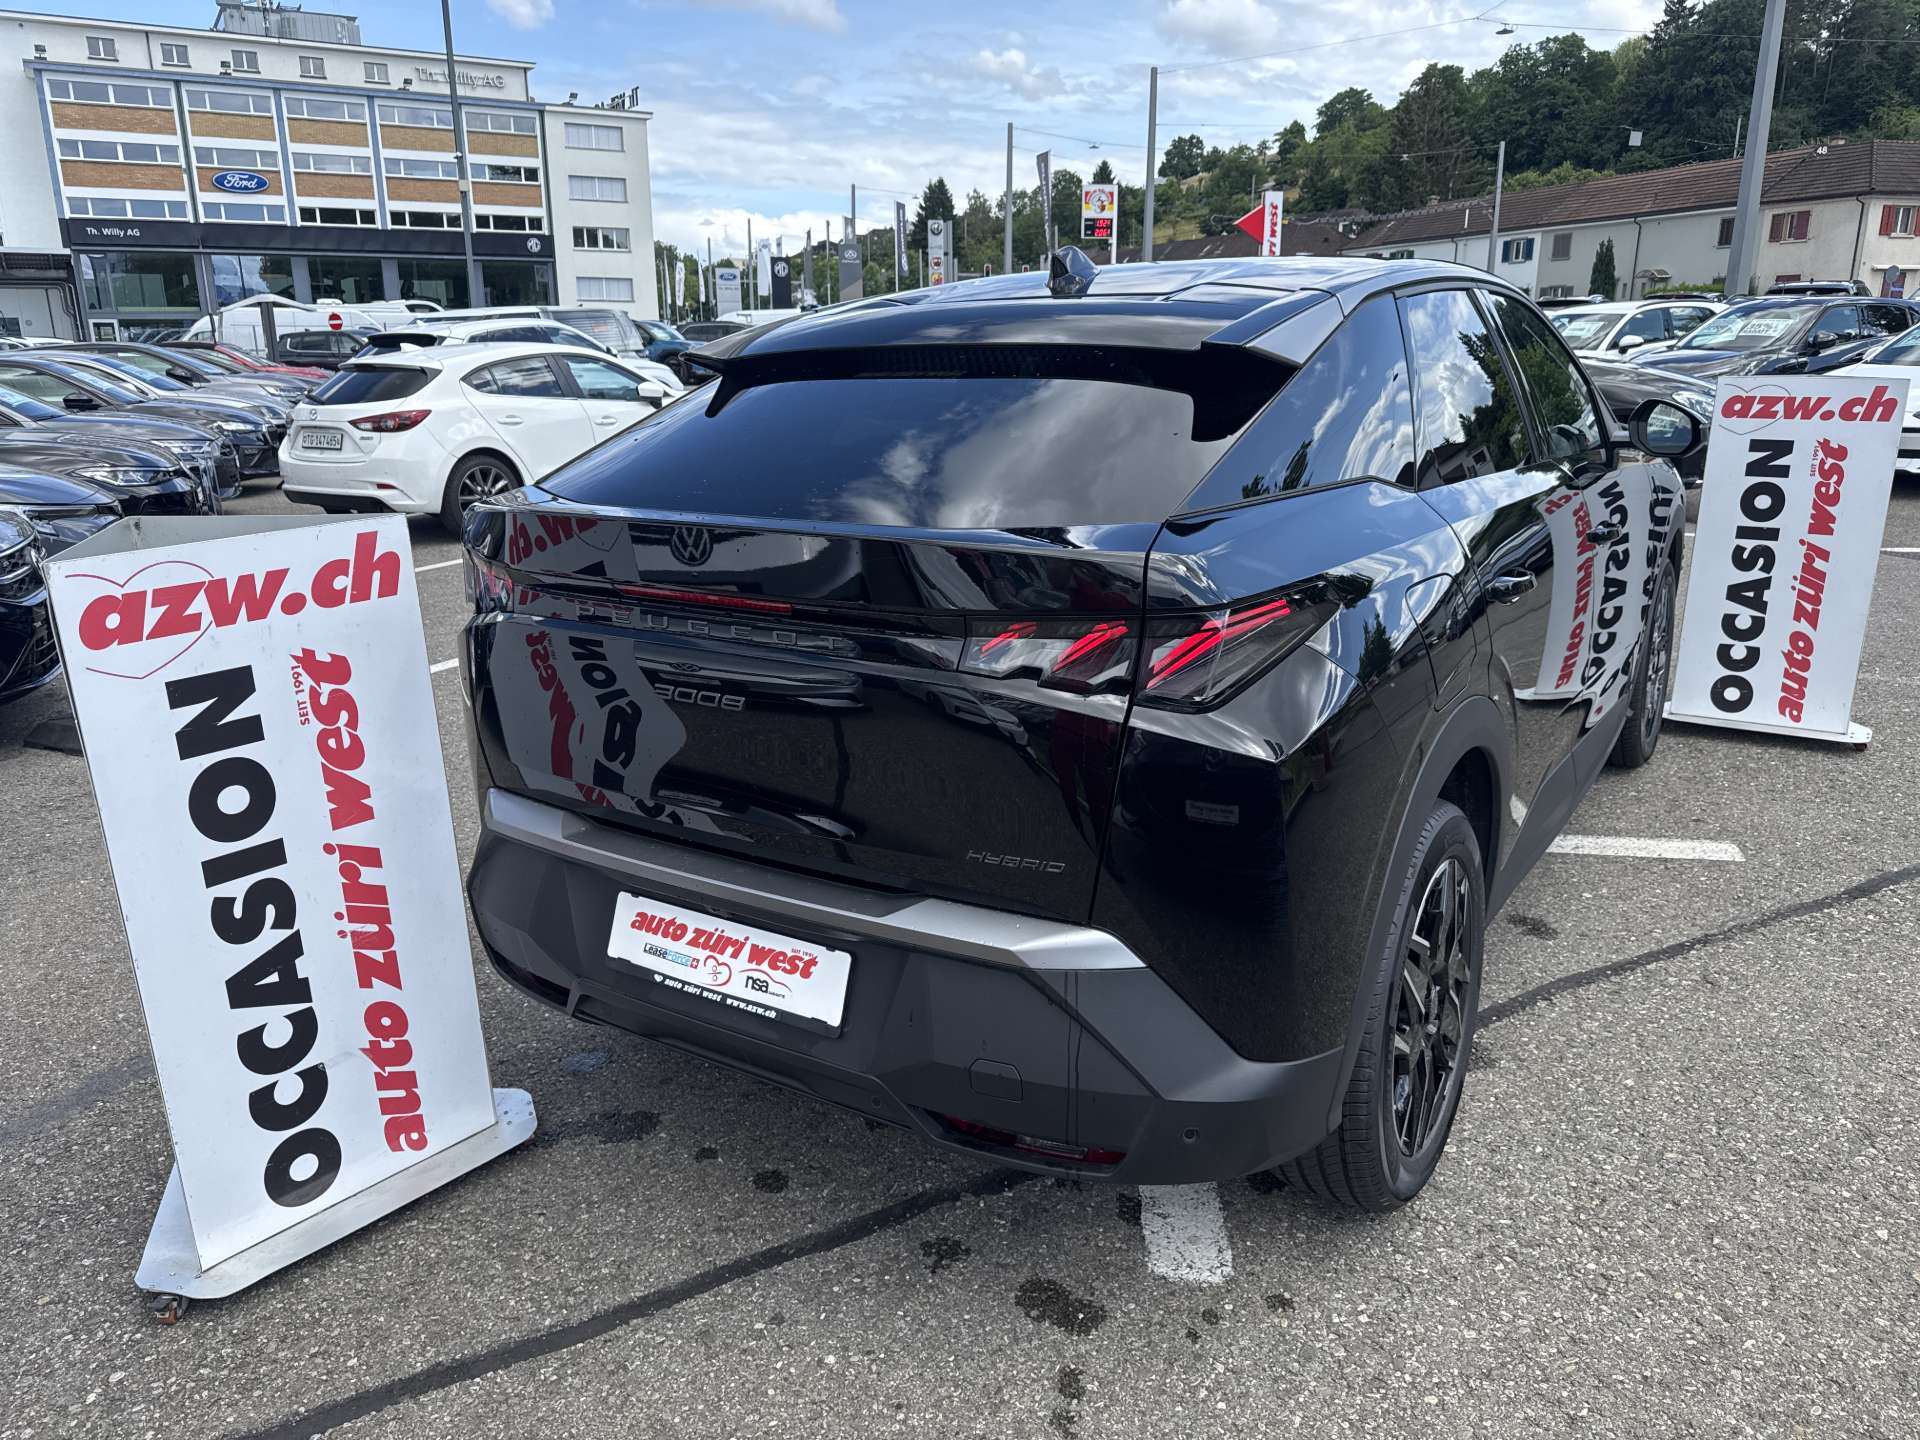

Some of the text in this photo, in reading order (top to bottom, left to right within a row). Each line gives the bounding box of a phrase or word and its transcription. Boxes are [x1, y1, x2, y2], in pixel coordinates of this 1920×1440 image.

[483, 73, 505, 88] AG
[1817, 146, 1828, 155] 48
[223, 173, 258, 189] Ford
[86, 227, 140, 238] Th. Willy AG
[527, 238, 541, 253] MG
[774, 262, 788, 277] MG
[1721, 385, 1898, 422] azw.ch
[78, 530, 400, 651] azw.ch
[1710, 438, 1795, 713] OCCASION
[1777, 437, 1849, 723] auto züri west
[575, 604, 844, 650] PEUGEOT
[291, 664, 311, 725] SEIT 1991
[654, 683, 745, 710] 3008
[966, 850, 1066, 873] HYBRID
[289, 647, 428, 1152] auto züri west
[165, 664, 342, 1208] OCCASION
[630, 911, 819, 979] auto züri west
[644, 943, 691, 965] LeaseForce
[664, 979, 682, 989] auto
[702, 990, 722, 1002] west
[726, 997, 777, 1019] www.azw.ch
[745, 975, 769, 994] nsa
